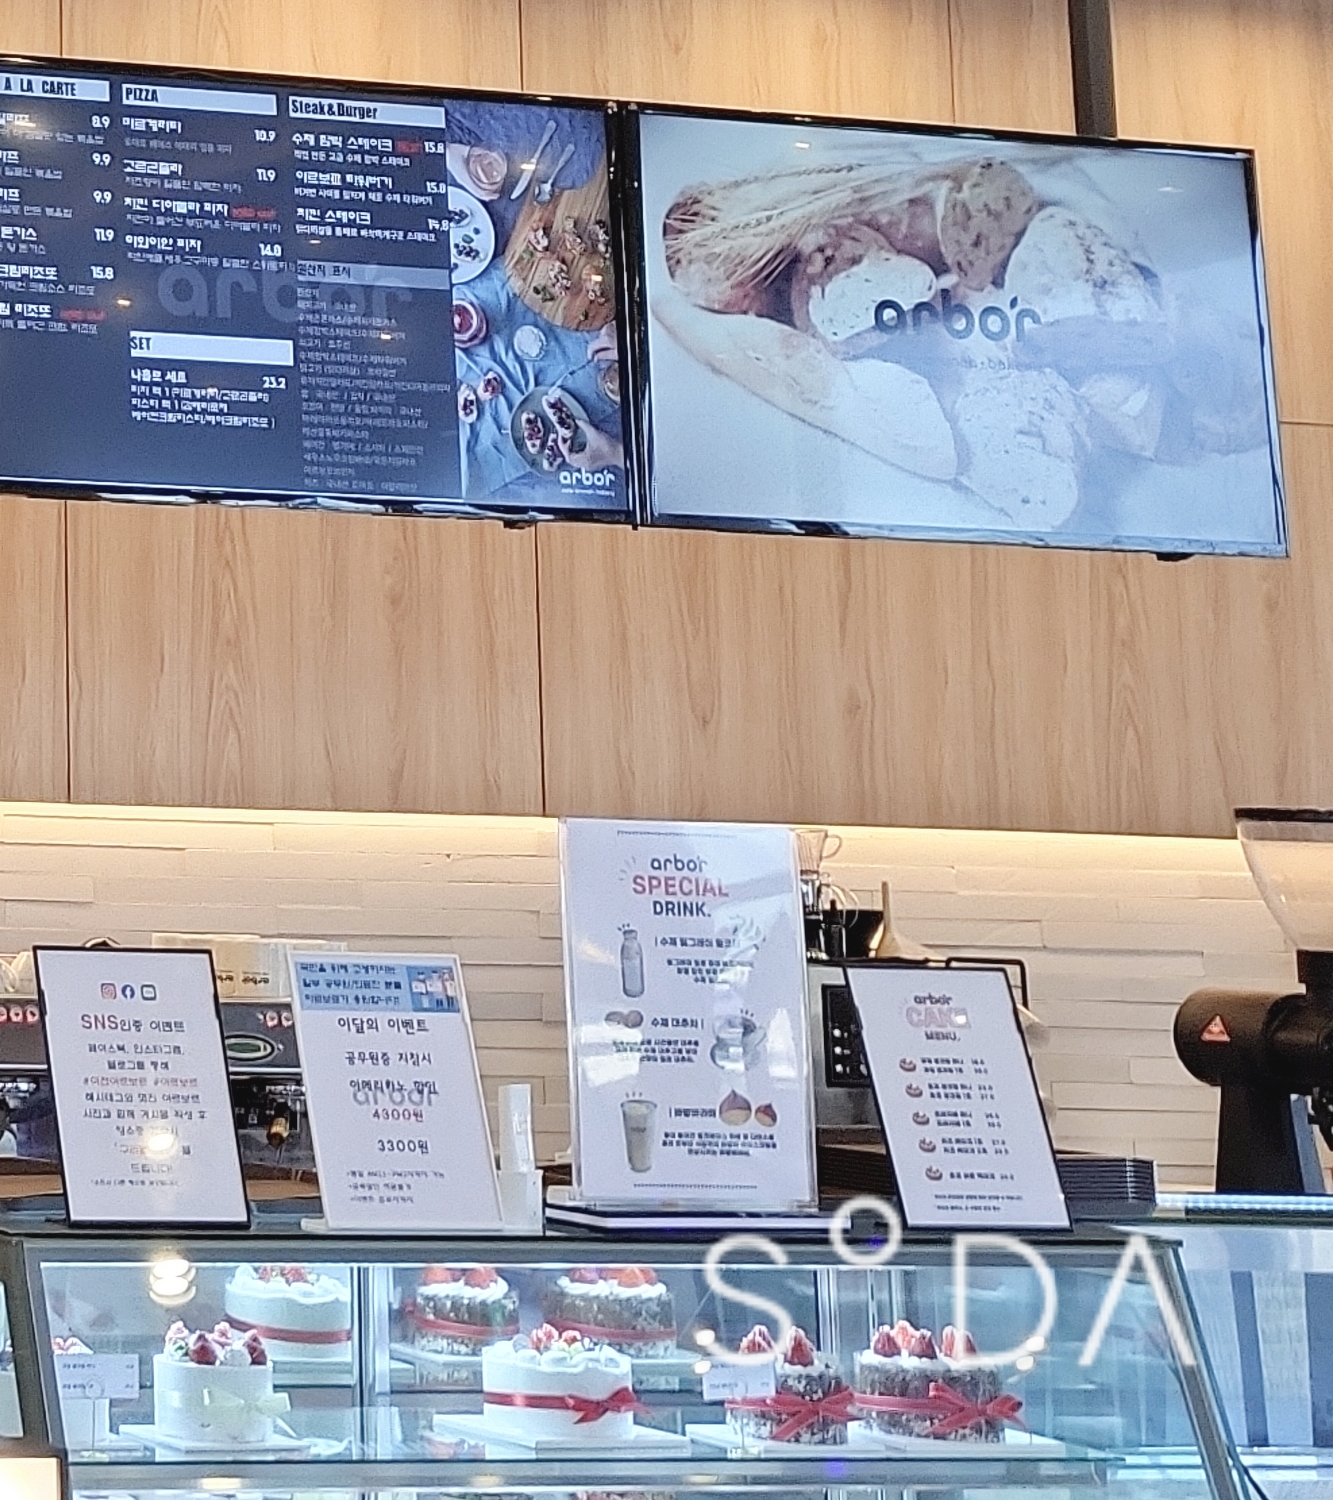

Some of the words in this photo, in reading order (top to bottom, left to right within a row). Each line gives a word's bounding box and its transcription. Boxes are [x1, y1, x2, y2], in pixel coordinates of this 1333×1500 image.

[5, 77, 12, 90] A
[20, 78, 33, 92] LA
[42, 80, 76, 96] CARTE
[126, 88, 159, 102] PIZZA
[291, 99, 378, 119] Steak&Burger
[93, 153, 110, 165] 9.9
[257, 169, 275, 181] 11.9
[93, 191, 111, 203] 9.9
[95, 228, 114, 241] 11.9
[131, 337, 152, 350] SET
[633, 875, 729, 897] SPECIAL
[652, 900, 711, 918] DRINK.
[338, 1018, 379, 1033] 이달의
[387, 1018, 429, 1034] 이벤트
[373, 1108, 423, 1122] 4300원
[377, 1140, 429, 1153] 3300원
